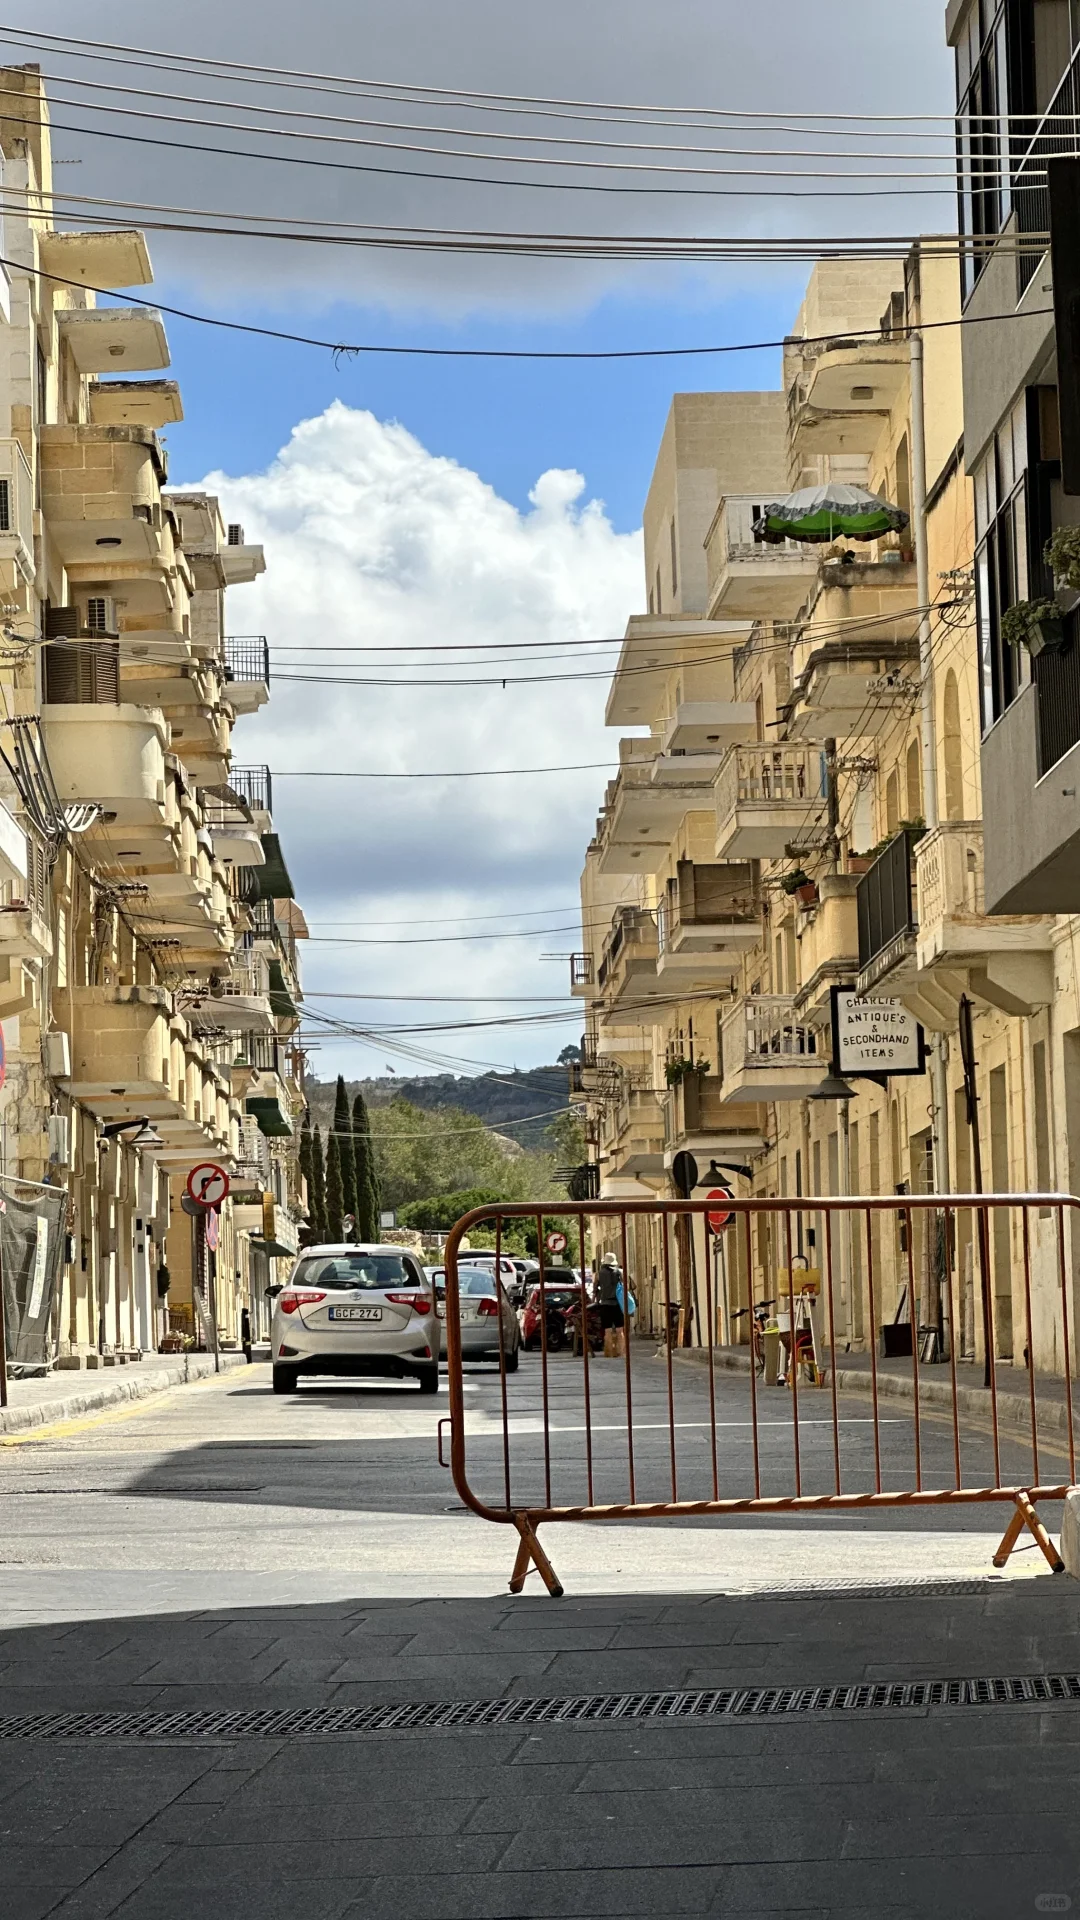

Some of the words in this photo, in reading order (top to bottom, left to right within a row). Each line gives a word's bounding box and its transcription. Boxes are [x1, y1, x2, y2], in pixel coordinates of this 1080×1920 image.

[848, 1013, 906, 1024] ANTIQUE'S
[871, 1025, 878, 1033] &
[843, 1035, 909, 1046] SECONDHAND
[860, 1049, 894, 1058] ITEMS
